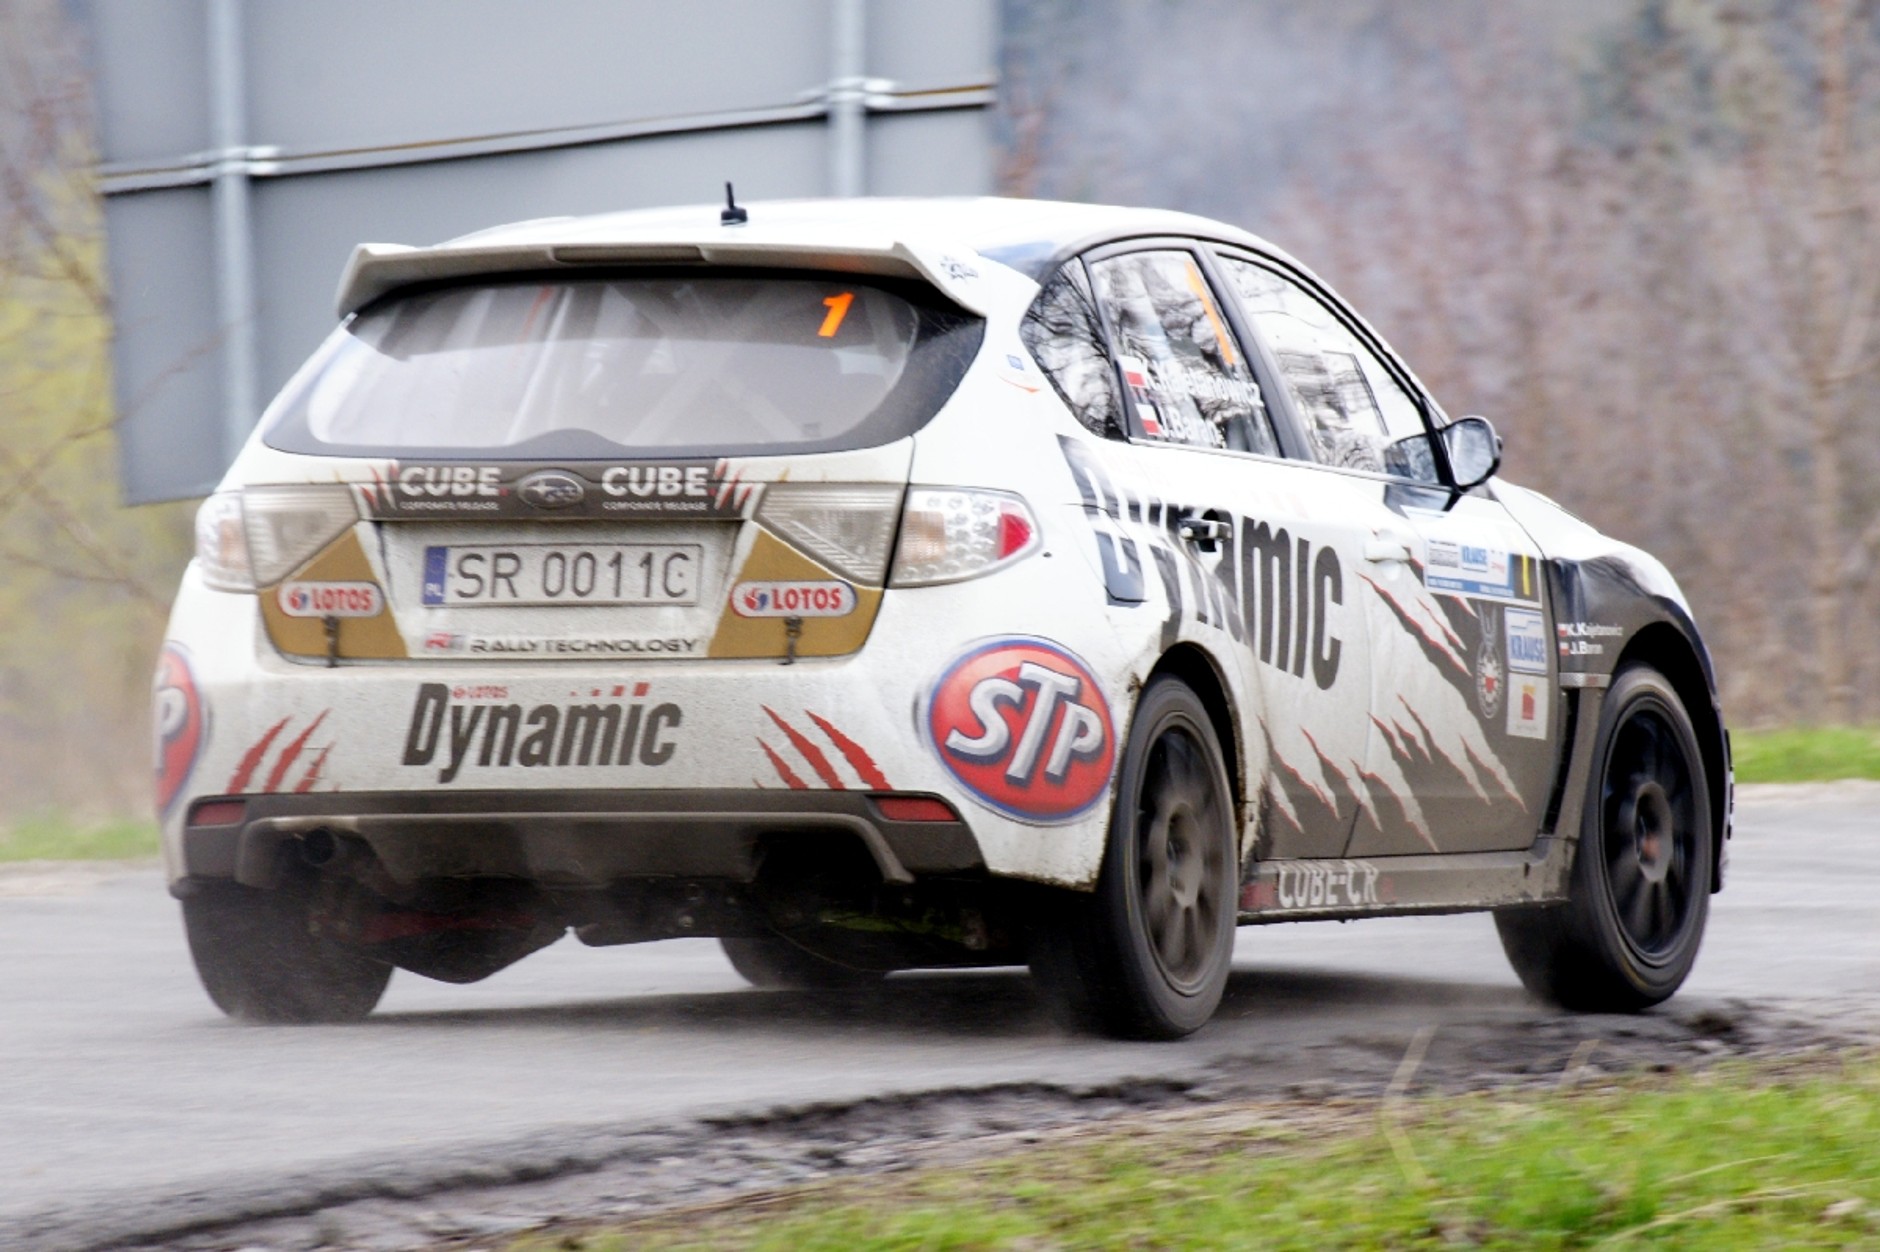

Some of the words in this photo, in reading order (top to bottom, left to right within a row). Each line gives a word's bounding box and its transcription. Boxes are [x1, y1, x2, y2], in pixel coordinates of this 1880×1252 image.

[818, 292, 854, 337] 1
[455, 551, 522, 598] SR
[542, 551, 691, 598] 0011C
[312, 588, 372, 611] LOTOS
[772, 587, 842, 610] LOTOS
[470, 639, 538, 652] RALLY
[544, 639, 699, 652] TECHNOLOGY
[402, 682, 682, 784] Dynamic
[945, 660, 1106, 787] STP
